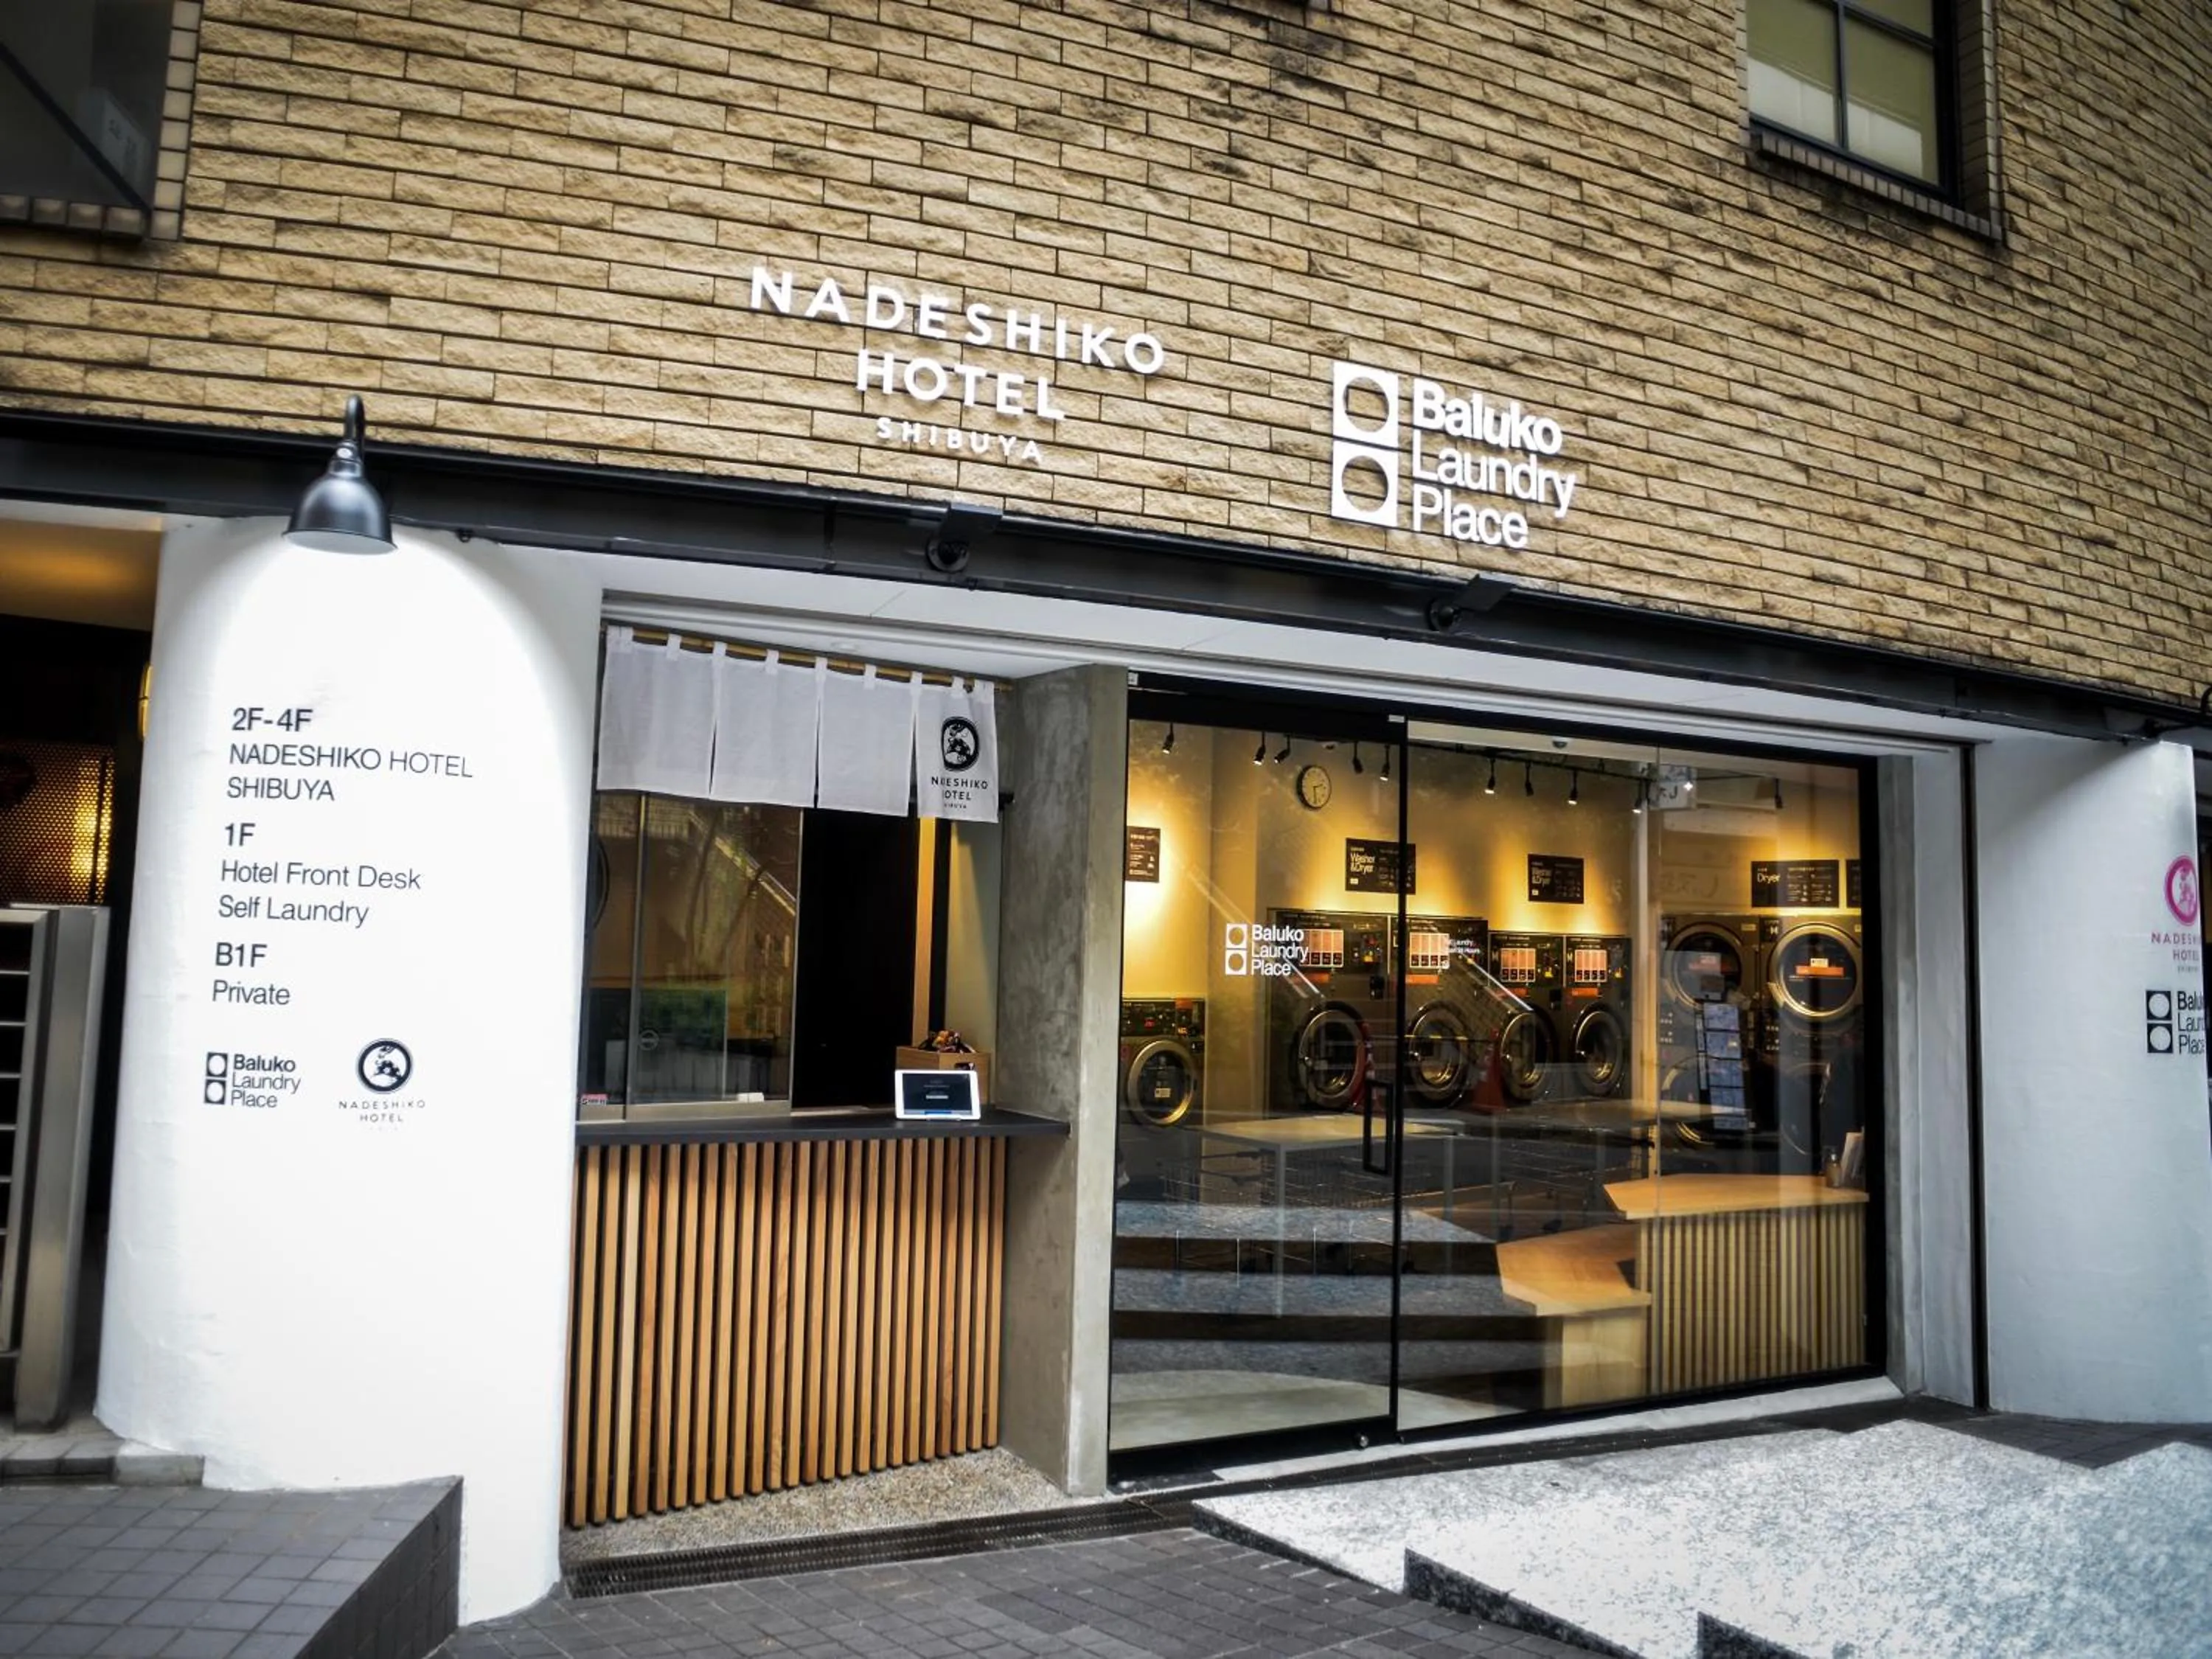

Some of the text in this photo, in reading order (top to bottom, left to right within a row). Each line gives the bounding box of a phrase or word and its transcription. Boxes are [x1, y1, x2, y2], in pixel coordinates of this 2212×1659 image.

[750, 266, 1166, 375] NADESHIKO
[856, 348, 1065, 420] HOTEL
[1413, 378, 1563, 455] Baluko
[877, 417, 1042, 466] SHIBUYA
[1413, 428, 1576, 518] Laundry
[1413, 483, 1529, 549] Place
[232, 707, 313, 731] 2F-4F
[229, 742, 473, 778] NADESHIKO HOTEL
[226, 776, 335, 801] SHIBUYA
[224, 822, 256, 846] 1F
[221, 860, 420, 890] Hotel Front Desk
[218, 894, 369, 929] Self Laundry
[1252, 923, 1304, 942] Baluko
[215, 942, 268, 967] B1F
[1252, 942, 1309, 963] Laundry
[1252, 959, 1292, 976] Place
[212, 979, 291, 1005] Private
[2177, 990, 2204, 1011] Balu
[233, 1054, 296, 1073] Baluko
[232, 1072, 301, 1094] Laundry
[230, 1090, 277, 1108] Place
[338, 1099, 426, 1110] NADESHIKO
[360, 1113, 404, 1123] HOTEL
